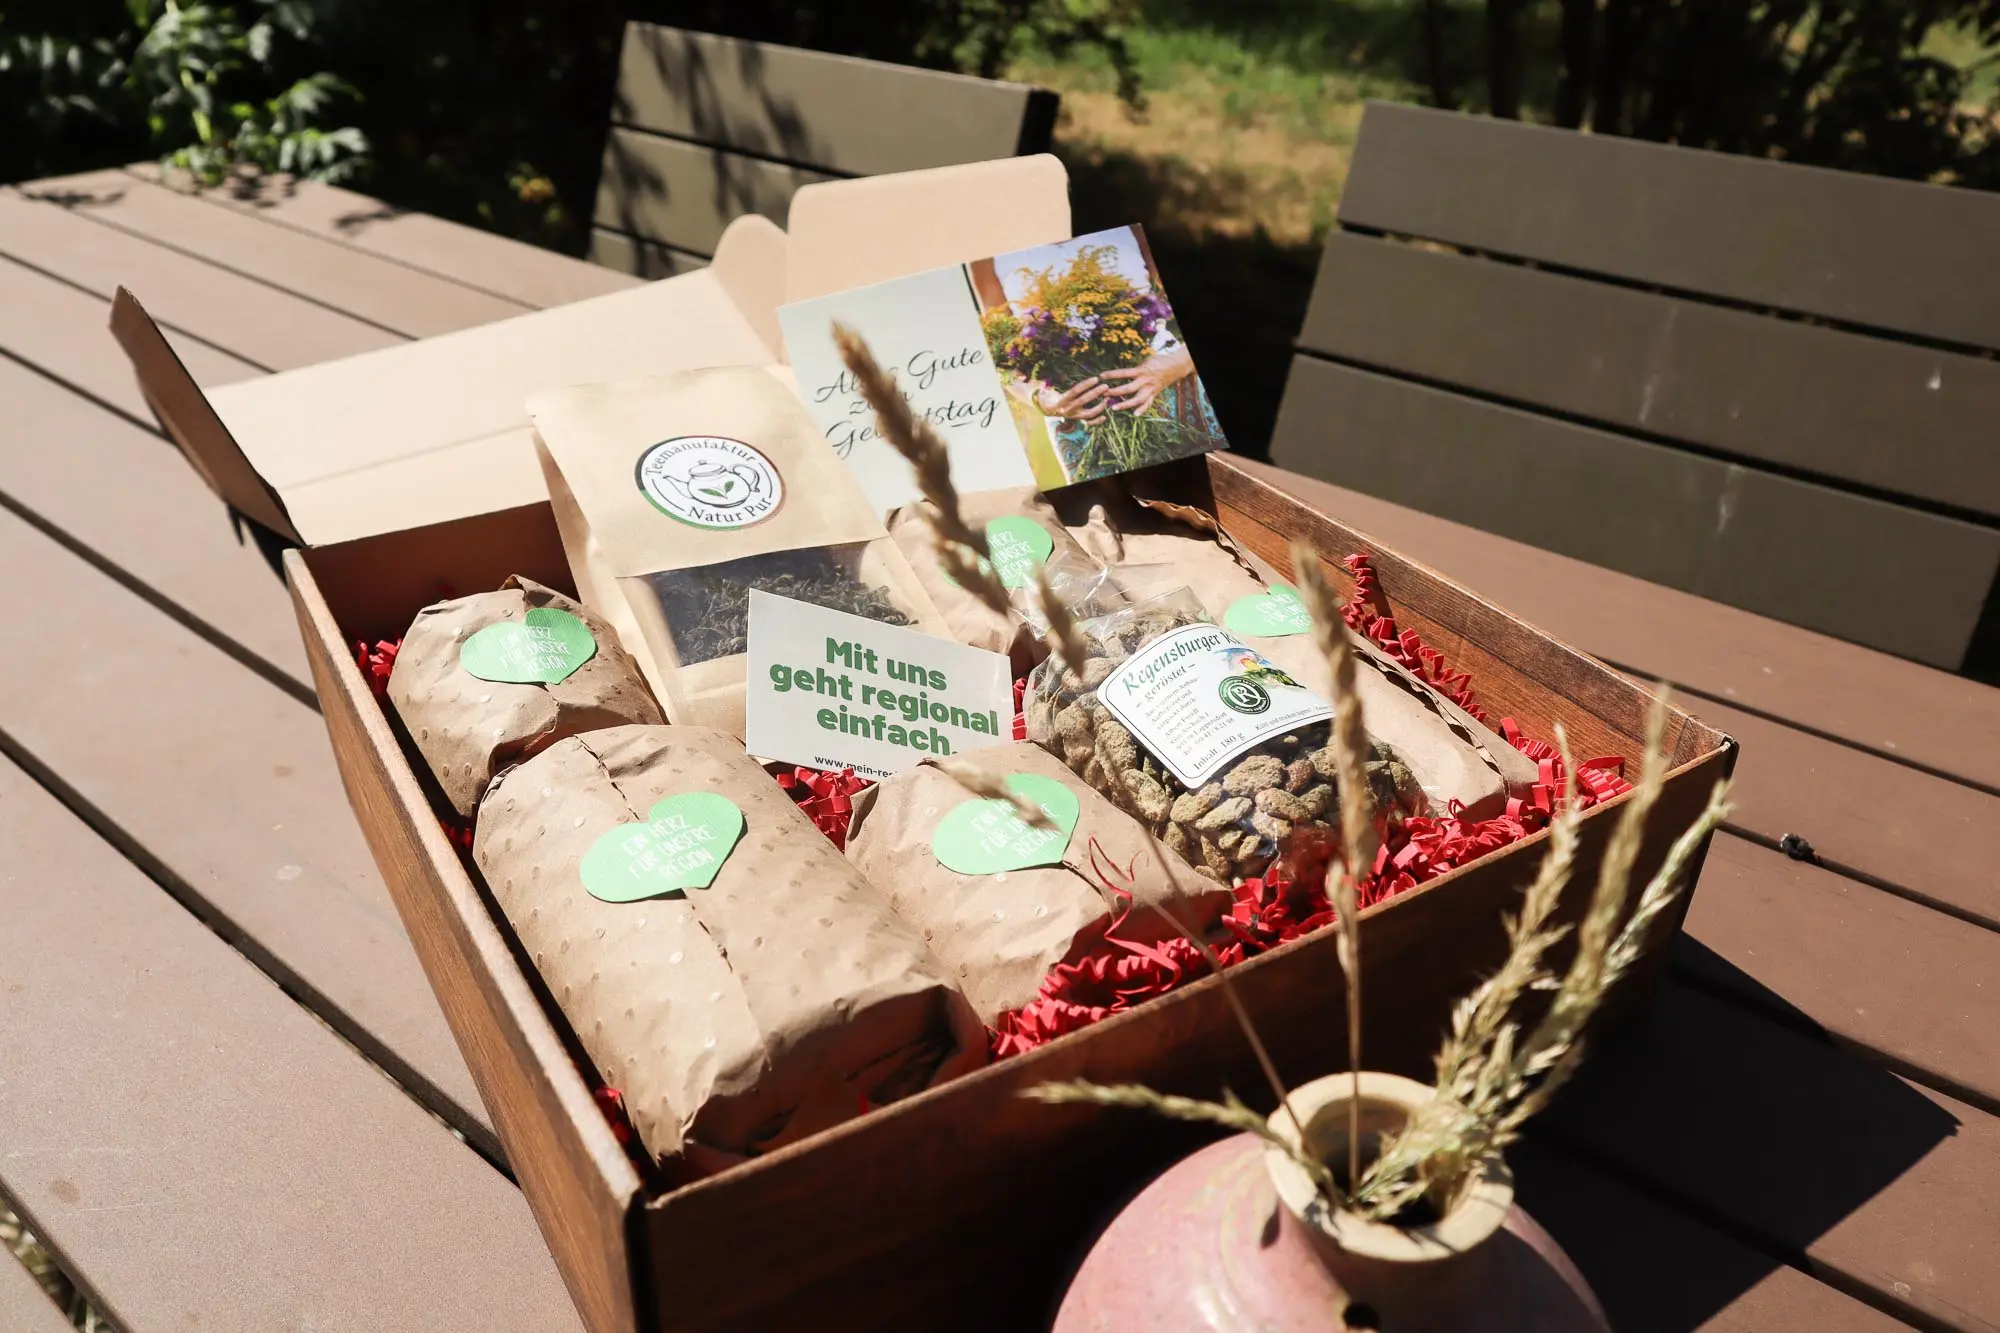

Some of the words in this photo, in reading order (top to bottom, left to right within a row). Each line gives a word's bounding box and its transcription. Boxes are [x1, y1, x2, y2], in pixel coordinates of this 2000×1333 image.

[907, 348, 985, 390] Gute
[645, 439, 756, 476] Teemanufaktur
[687, 506, 742, 523] Natur
[745, 497, 773, 516] Pur
[826, 637, 878, 675] Mit
[886, 658, 947, 691] uns
[769, 663, 853, 701] geht
[861, 683, 999, 736] regional
[1144, 665, 1188, 701] geröstet
[651, 814, 692, 838] HERZ
[656, 825, 717, 855] UNSERE
[660, 848, 715, 882] REGION
